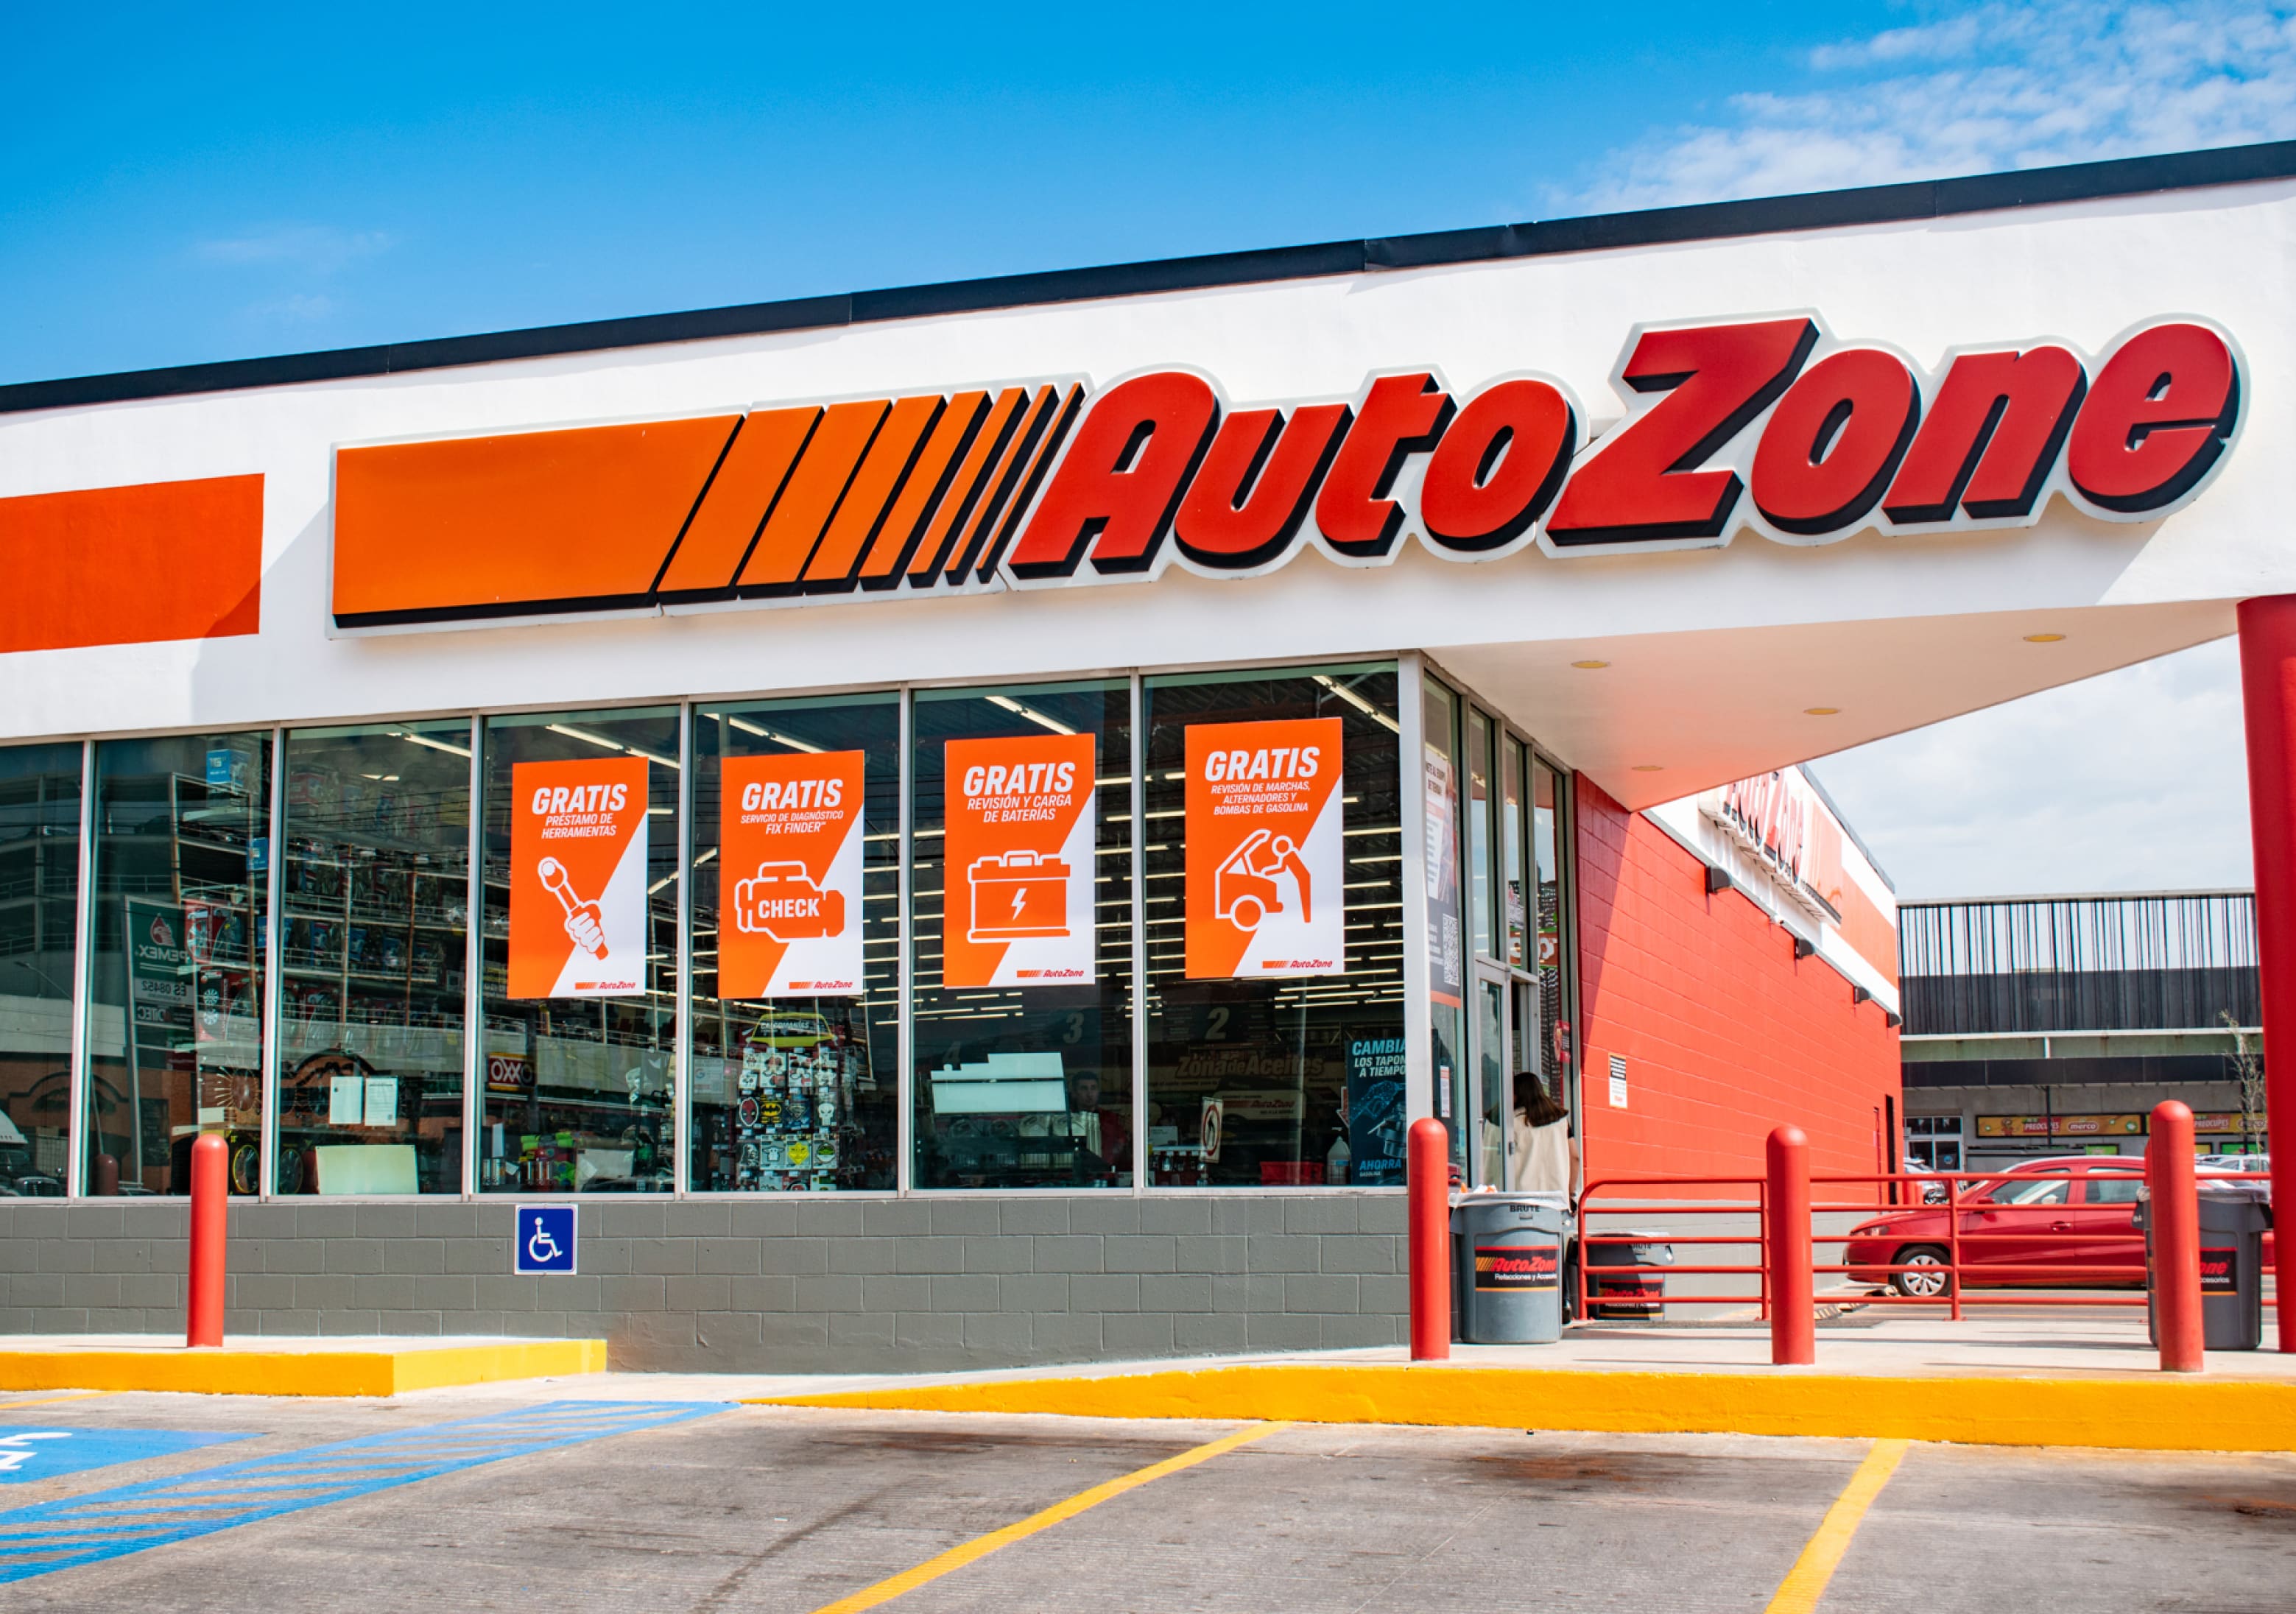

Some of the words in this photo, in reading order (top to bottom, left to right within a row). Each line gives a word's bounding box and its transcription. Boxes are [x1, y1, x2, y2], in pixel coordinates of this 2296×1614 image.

[1007, 318, 2239, 579] AutoZone
[1205, 746, 1320, 781] GRATIS
[963, 761, 1075, 796] GRATIS
[742, 778, 843, 811] GRATIS
[1211, 782, 1250, 794] REVISIÓN
[1253, 783, 1264, 792] DE
[1265, 781, 1310, 792] MARCHAS,
[532, 783, 628, 815] GRATIS
[968, 793, 1021, 811] REVISIÓN
[1024, 796, 1032, 808] Y
[1033, 794, 1072, 807] CARGA
[1222, 793, 1288, 804] ALTERNADORES
[1290, 792, 1297, 801] Y
[741, 814, 776, 824] SERVICIO
[778, 813, 789, 822] DE
[791, 809, 844, 821] DIAGNÓSTICO
[983, 810, 999, 823] DE
[1001, 806, 1056, 822] BATERÍAS
[1213, 805, 1250, 816] BOMBAS
[1253, 804, 1264, 814] DE
[1266, 803, 1309, 813] GASOLINA
[545, 812, 597, 826] PRÉSTAMO
[600, 813, 613, 824] DE
[541, 825, 616, 839] HERRAMIENTAS
[766, 823, 783, 835] FIX
[758, 898, 820, 919] CHECK
[1290, 959, 1332, 968] AutoZone
[1043, 968, 1084, 978] AutoZone
[599, 981, 636, 989] AutoZone
[814, 980, 853, 989] AutoZone
[1205, 1007, 1230, 1040] 2
[1355, 1057, 1373, 1068] LOS
[1375, 1055, 1406, 1067] TAPON
[491, 1058, 532, 1084] OXXO
[1359, 1068, 1367, 1078] A
[1359, 1159, 1402, 1171] AHORRA
[1510, 1205, 1540, 1213] BRUTE
